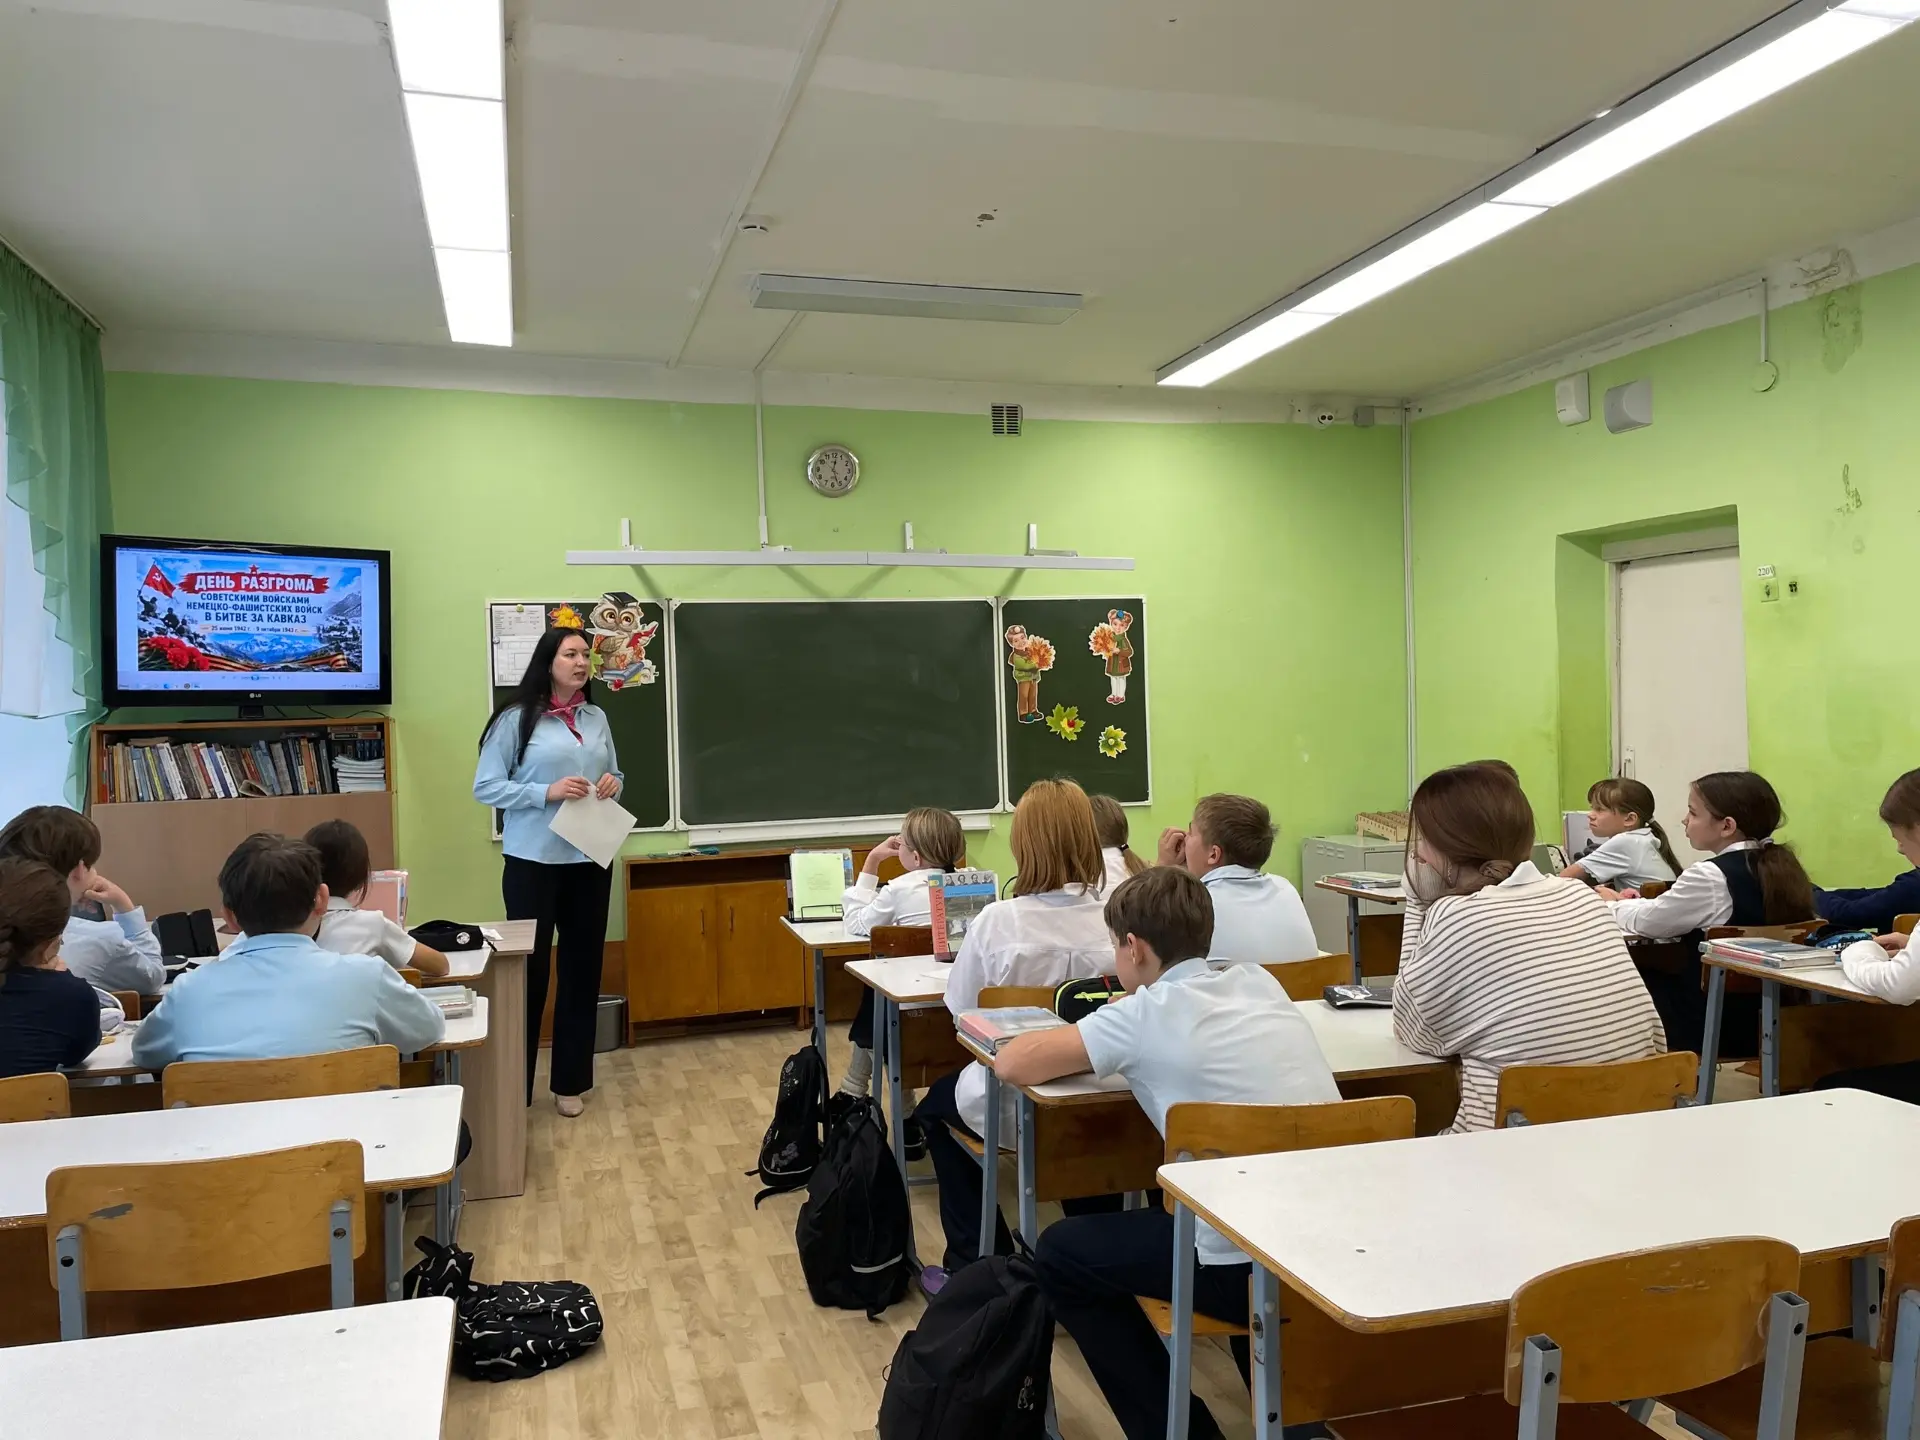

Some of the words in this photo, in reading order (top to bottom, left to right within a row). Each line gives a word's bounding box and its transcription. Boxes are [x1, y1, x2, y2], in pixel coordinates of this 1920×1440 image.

[194, 575, 235, 590] ДЕНЬ
[241, 576, 314, 591] РАЗГРОМА
[200, 593, 260, 602] СОВЕТСКИМИ
[262, 594, 310, 604] ВОЙСКАМИ
[186, 602, 292, 612] НЕМЕЦКО-ФАШИСТСКИХ
[295, 604, 322, 614] ВОЙСК
[205, 612, 212, 620] В
[216, 612, 248, 622] БИТВЕ
[251, 613, 264, 622] ЗА
[267, 614, 306, 623] КАВКАЗ
[936, 888, 946, 950] ЛИТЕРАТУРА
